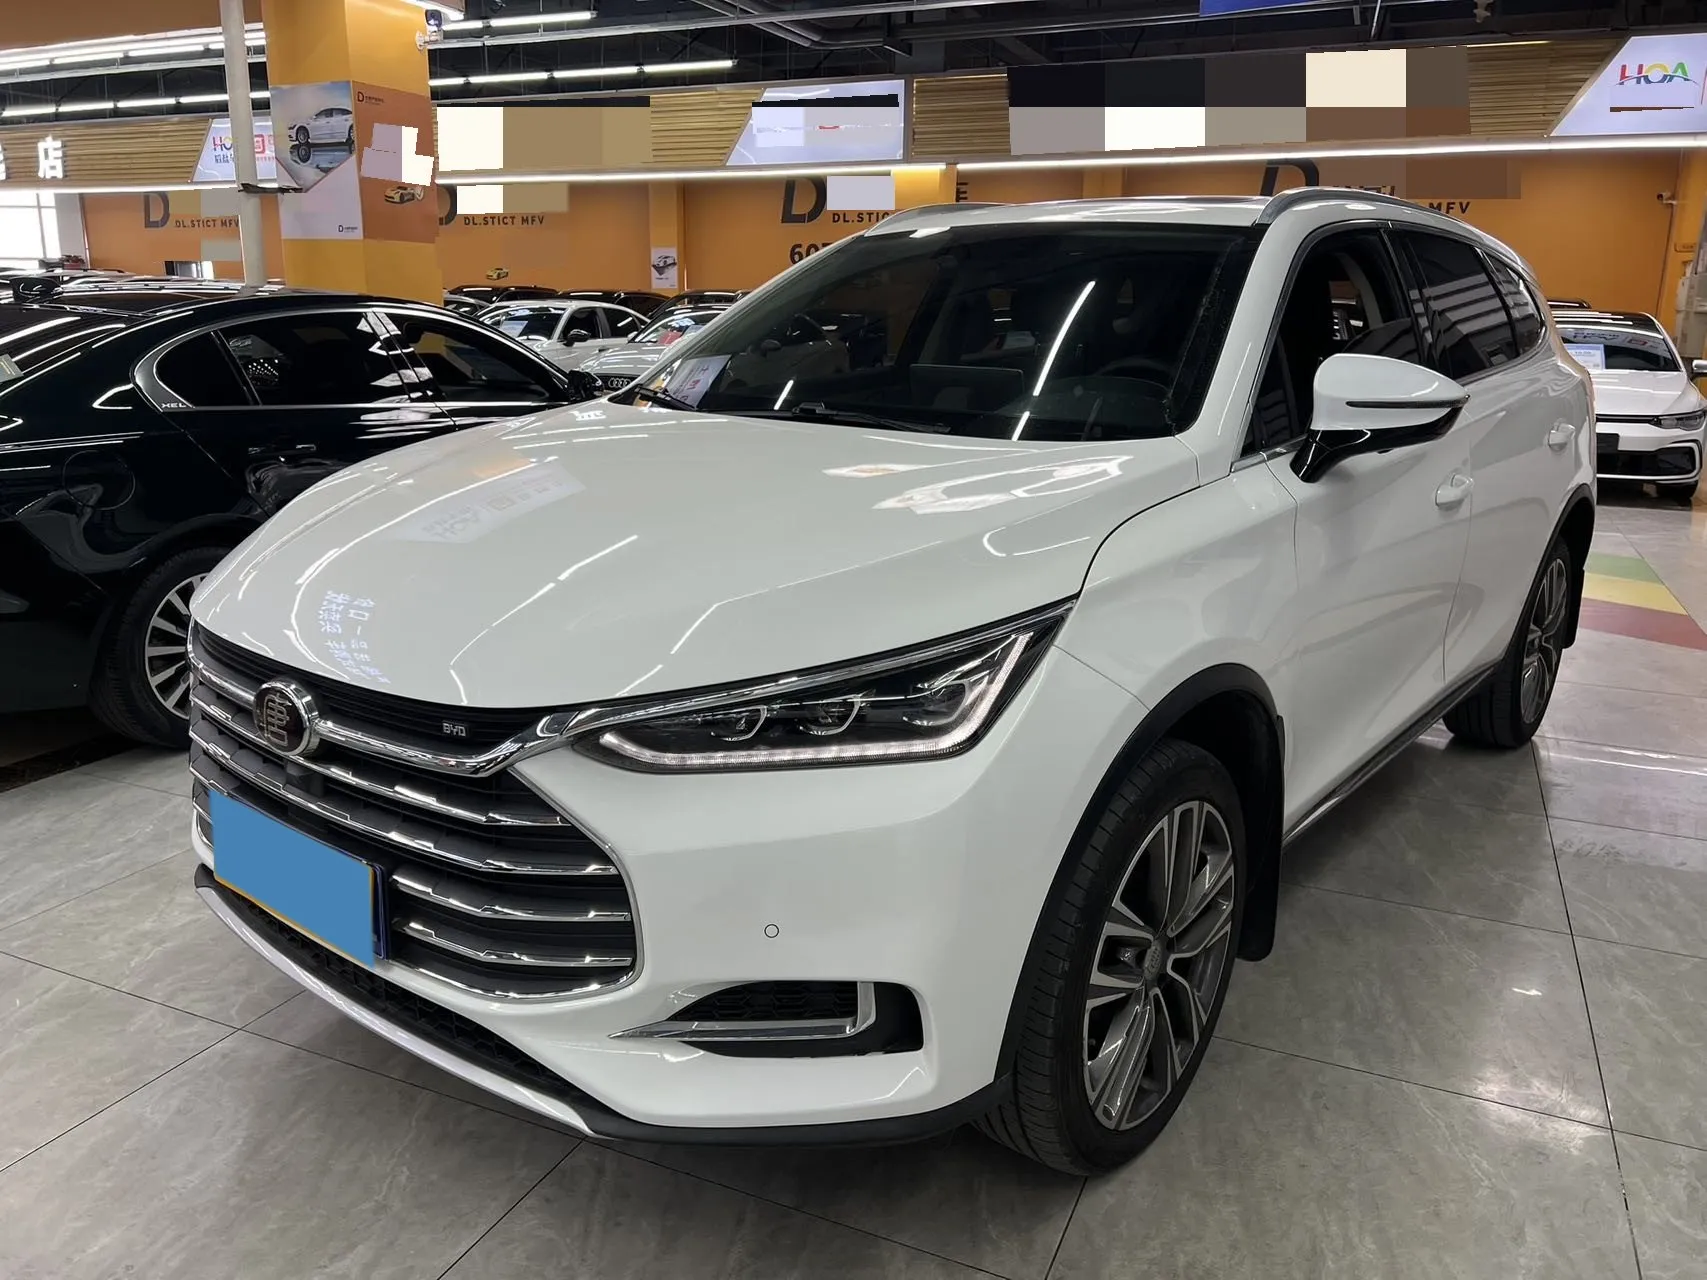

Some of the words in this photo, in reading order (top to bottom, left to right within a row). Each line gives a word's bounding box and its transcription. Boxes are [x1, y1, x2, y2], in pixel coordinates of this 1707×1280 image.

[1617, 62, 1694, 85] HOA
[212, 136, 234, 152] HO
[220, 218, 240, 229] MFV
[463, 215, 516, 226] DL.STICT
[520, 215, 545, 226] MFV
[831, 211, 890, 223] DL.STIC
[442, 722, 467, 737] BYD
